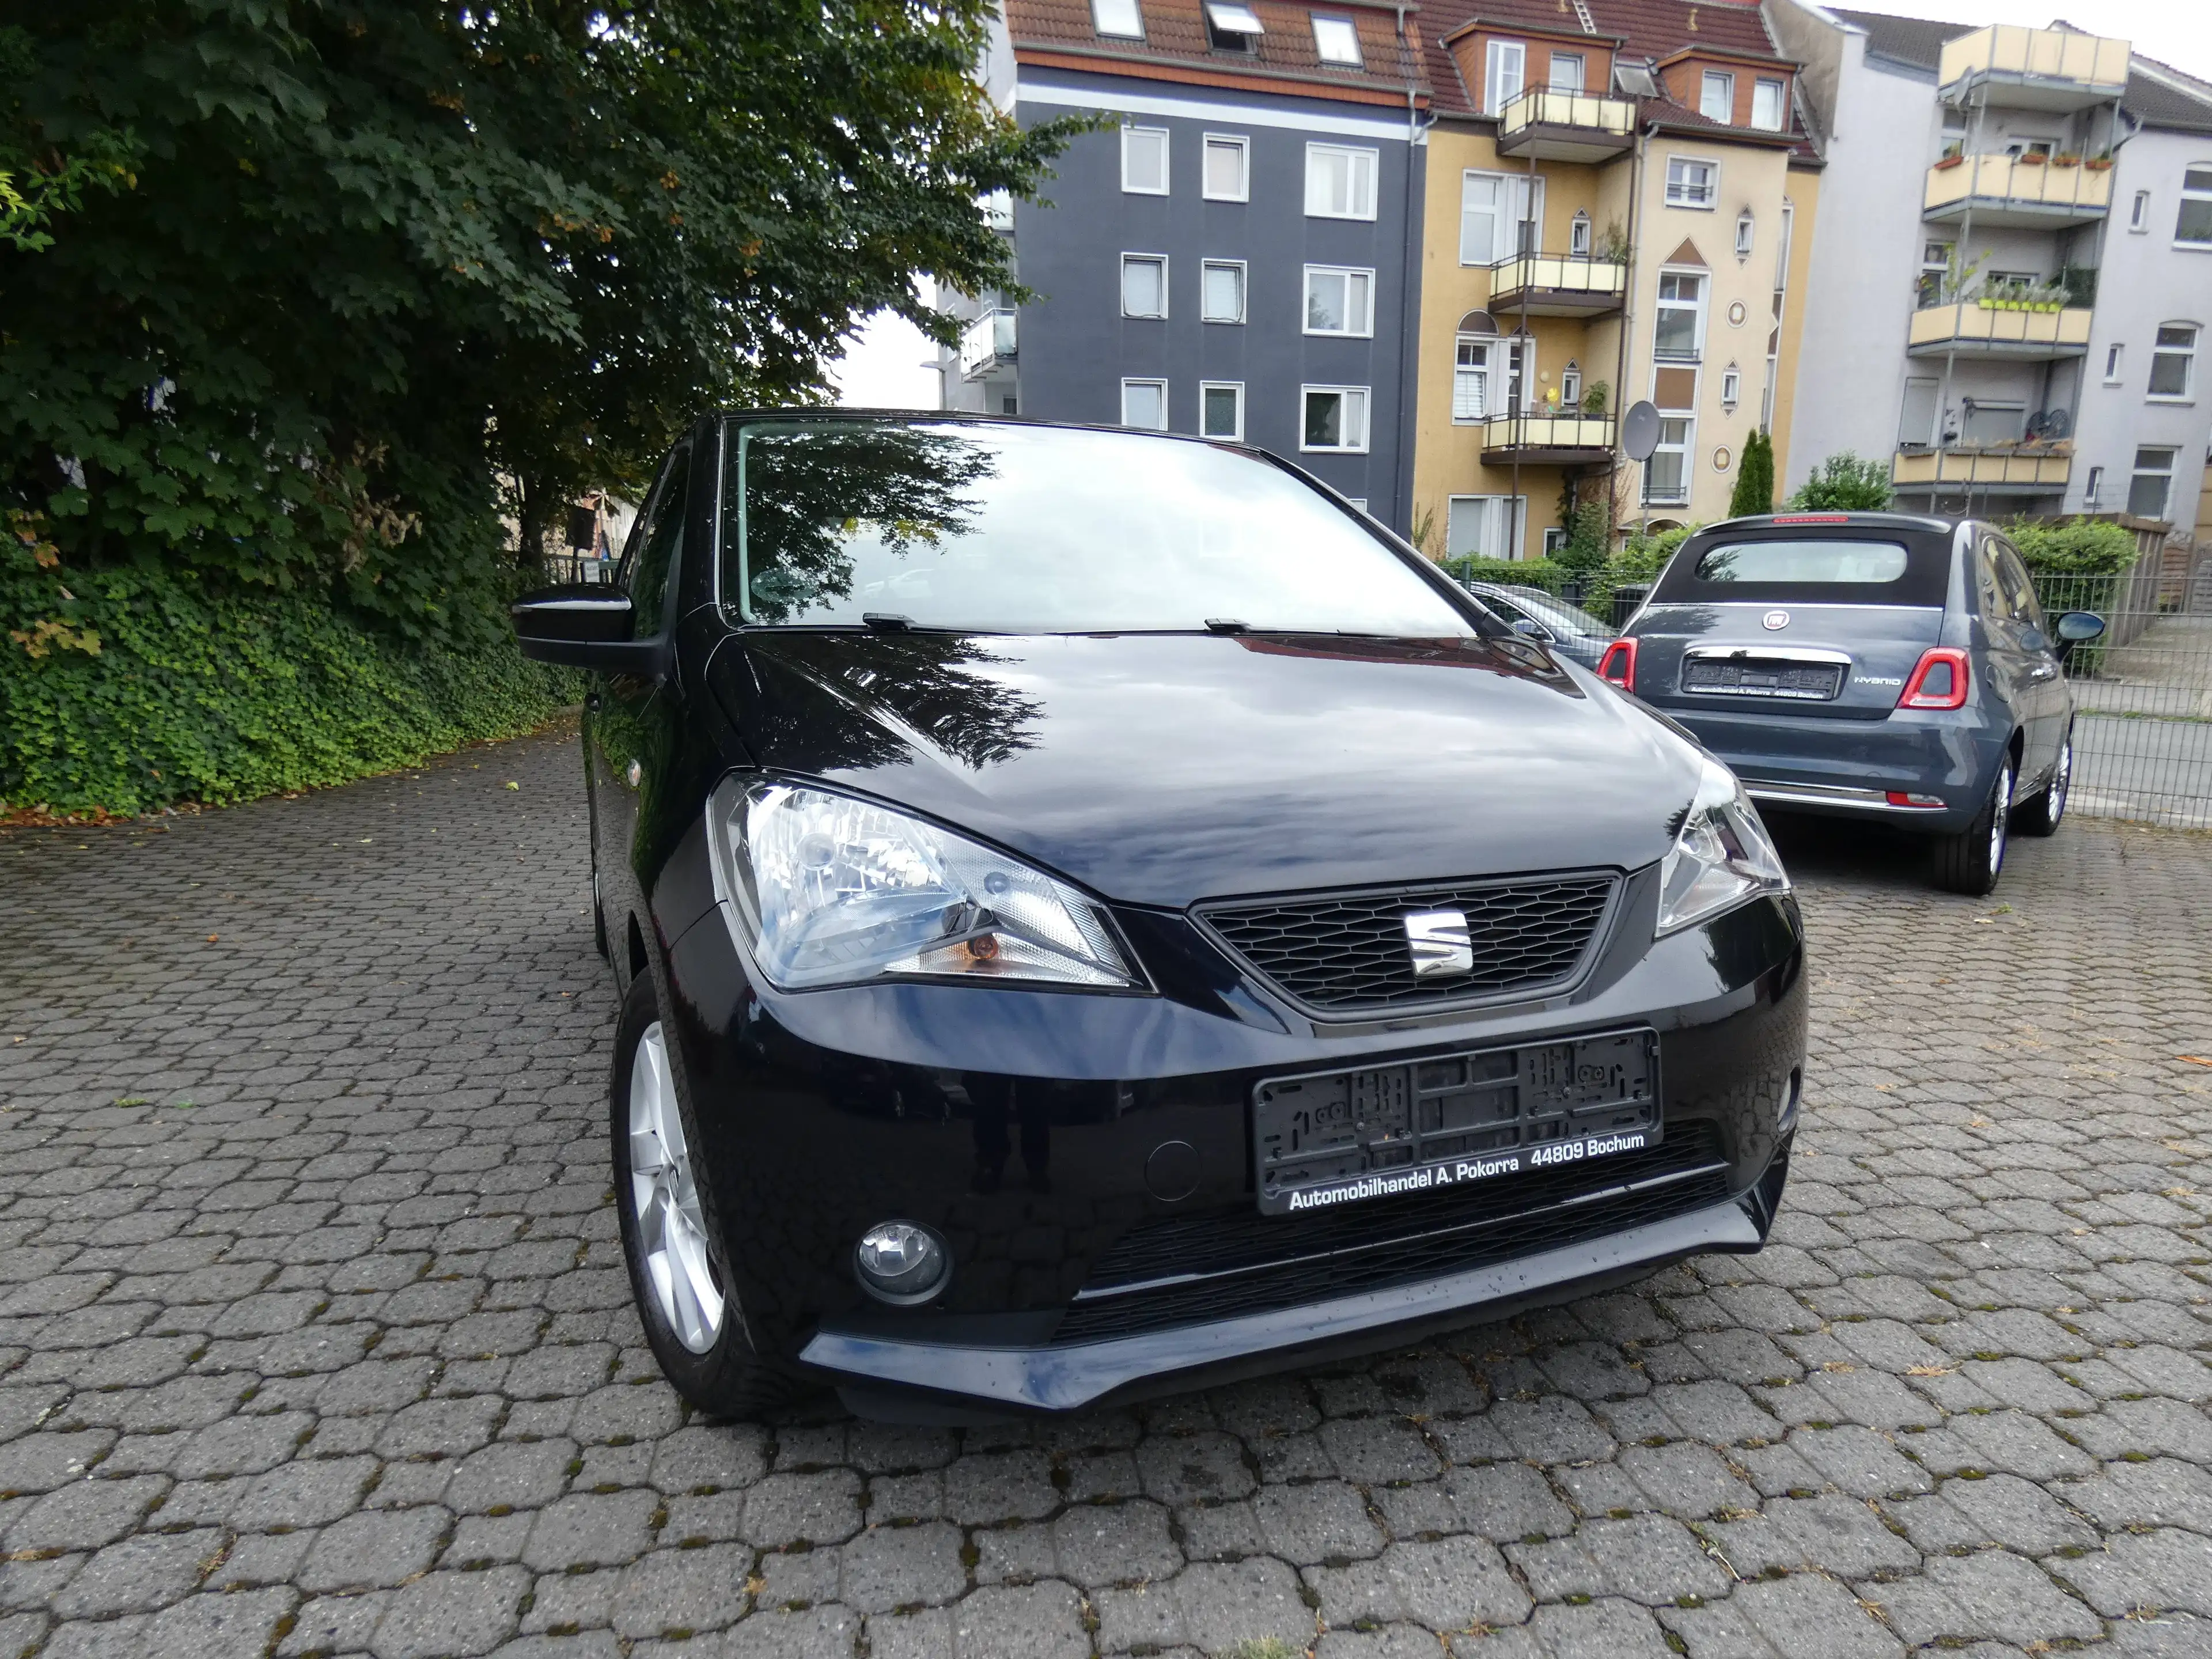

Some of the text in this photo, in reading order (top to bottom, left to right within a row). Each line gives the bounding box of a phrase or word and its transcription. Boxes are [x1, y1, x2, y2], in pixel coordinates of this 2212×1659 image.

[1854, 676, 1901, 685] HYBRID
[1691, 687, 1738, 695] Automobilhandel
[1289, 1135, 1645, 1210] Automobilhandel A. Pokorra 44809 Bochum
